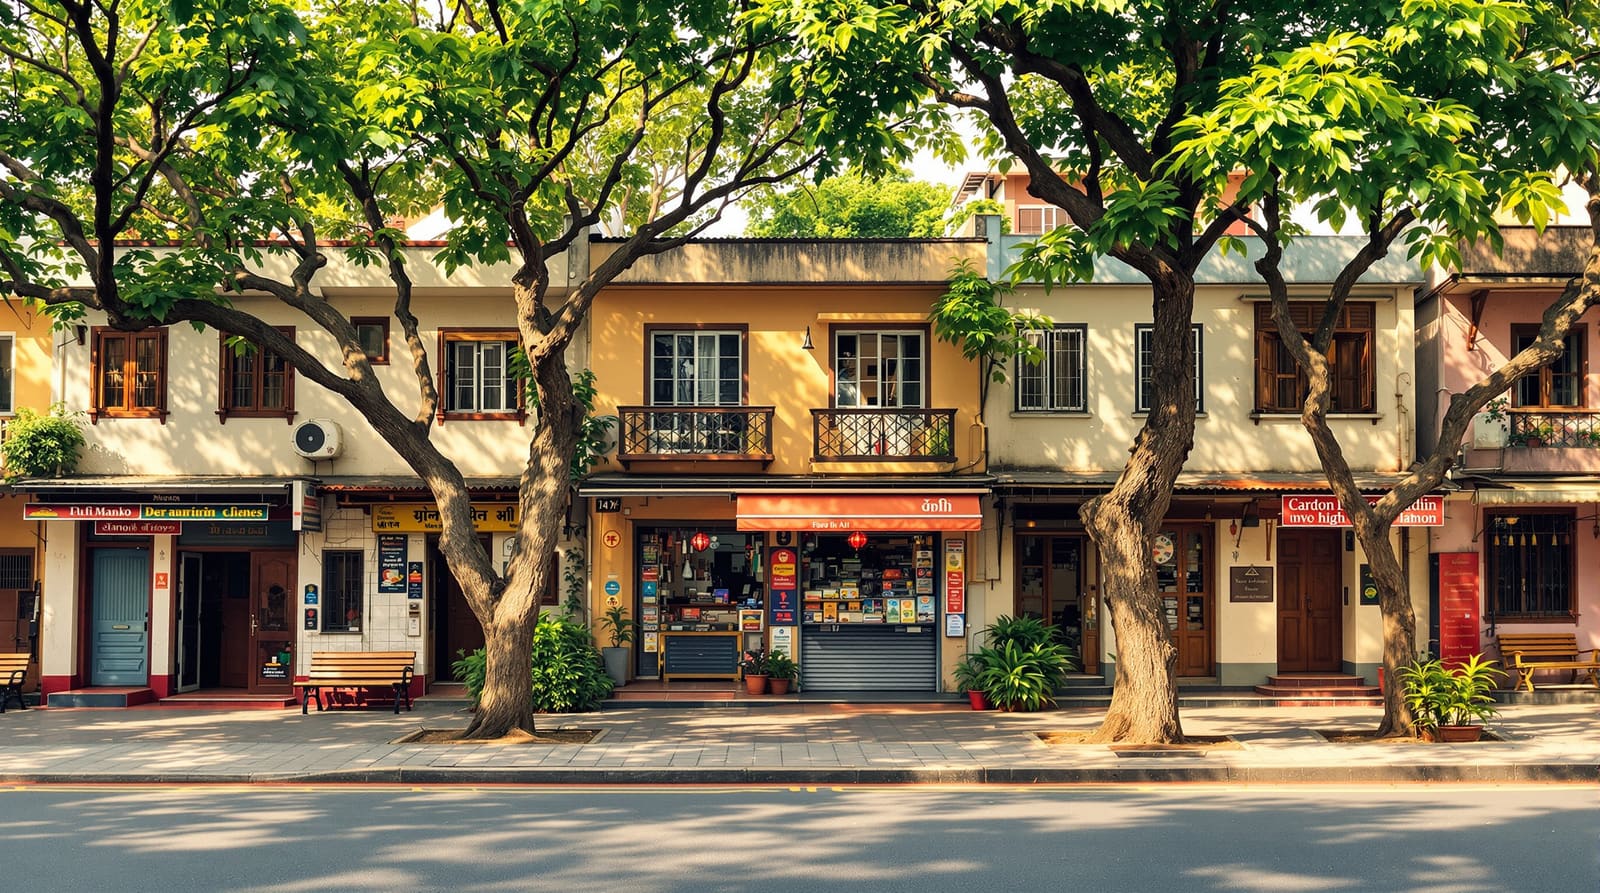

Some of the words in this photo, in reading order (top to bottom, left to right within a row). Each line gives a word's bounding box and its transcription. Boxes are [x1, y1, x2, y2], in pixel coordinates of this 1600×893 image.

[1288, 498, 1335, 511] Cardon
[95, 506, 132, 517] Manko
[144, 506, 167, 517] Der
[1318, 511, 1345, 526] high
